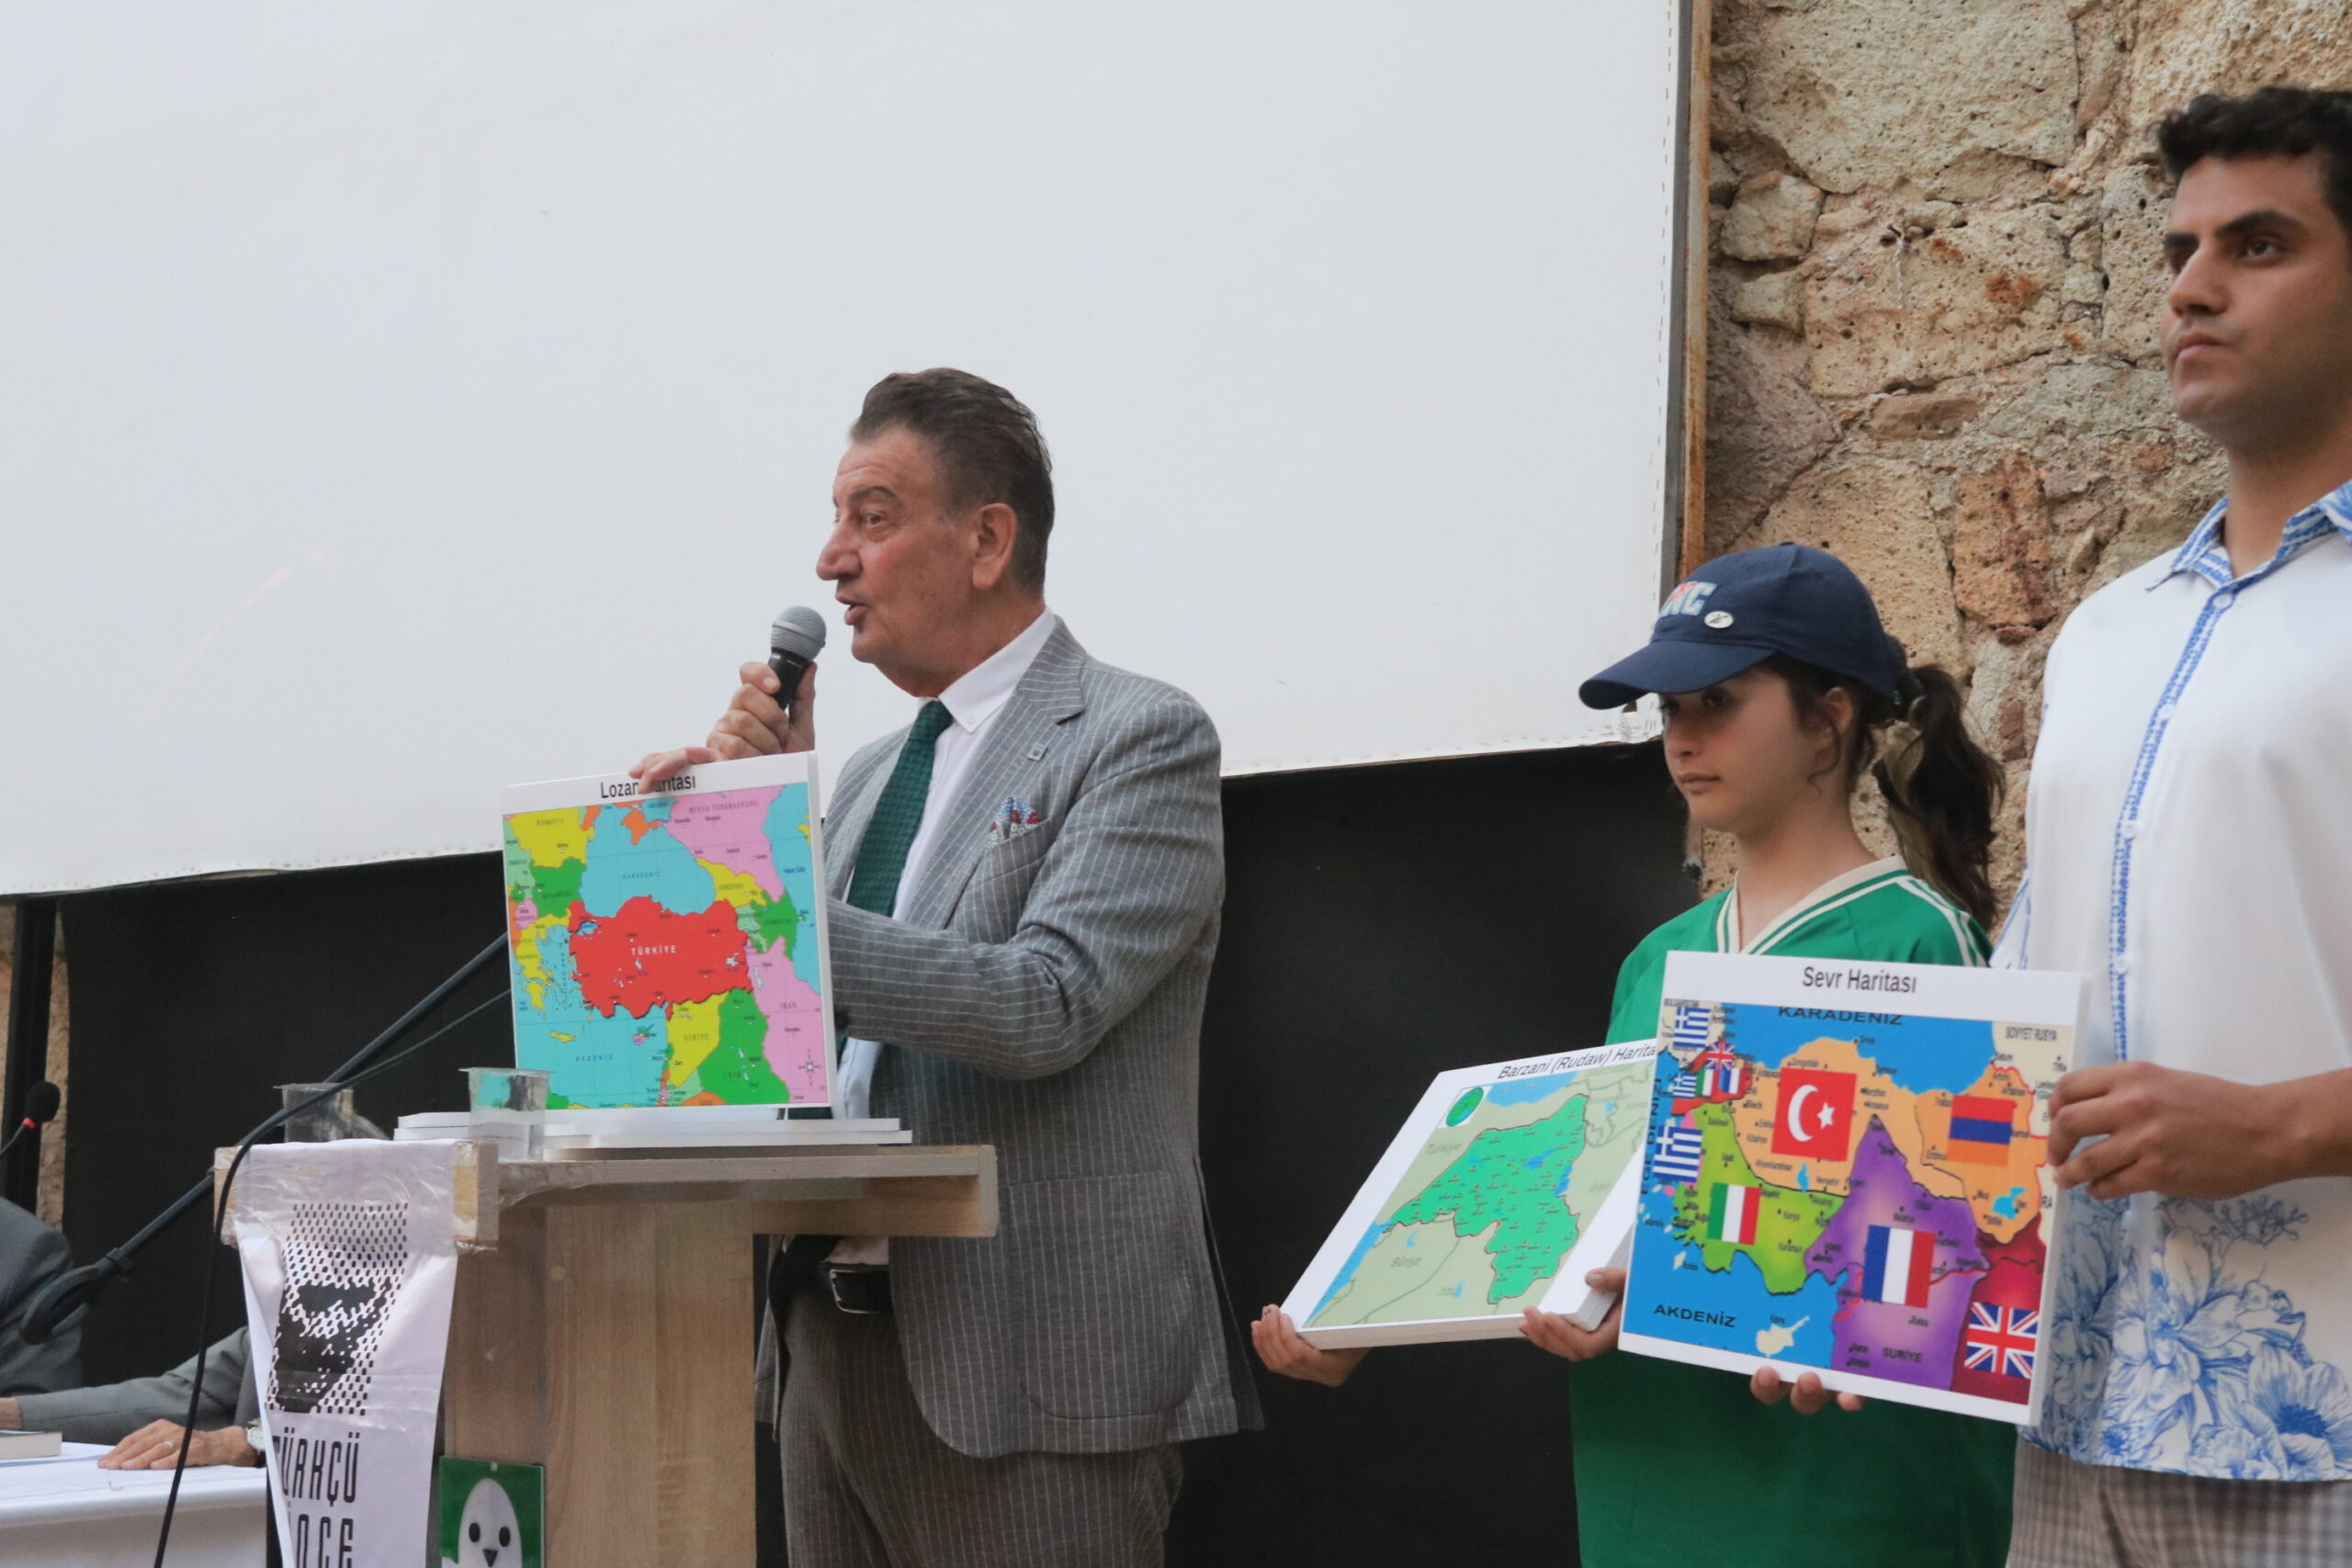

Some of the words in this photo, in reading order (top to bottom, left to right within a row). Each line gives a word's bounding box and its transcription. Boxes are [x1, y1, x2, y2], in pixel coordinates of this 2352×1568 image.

[631, 944, 676, 955] TÜRKİYE
[1803, 966, 1843, 988] Sevr
[1847, 969, 1917, 993] Haritası
[1498, 1060, 1553, 1079] Barzani
[1551, 1049, 1613, 1074] (Rudaw)
[1612, 1043, 1657, 1063] Harita
[1654, 1304, 1736, 1328] AKDENİZ
[288, 1514, 354, 1568] NCE
